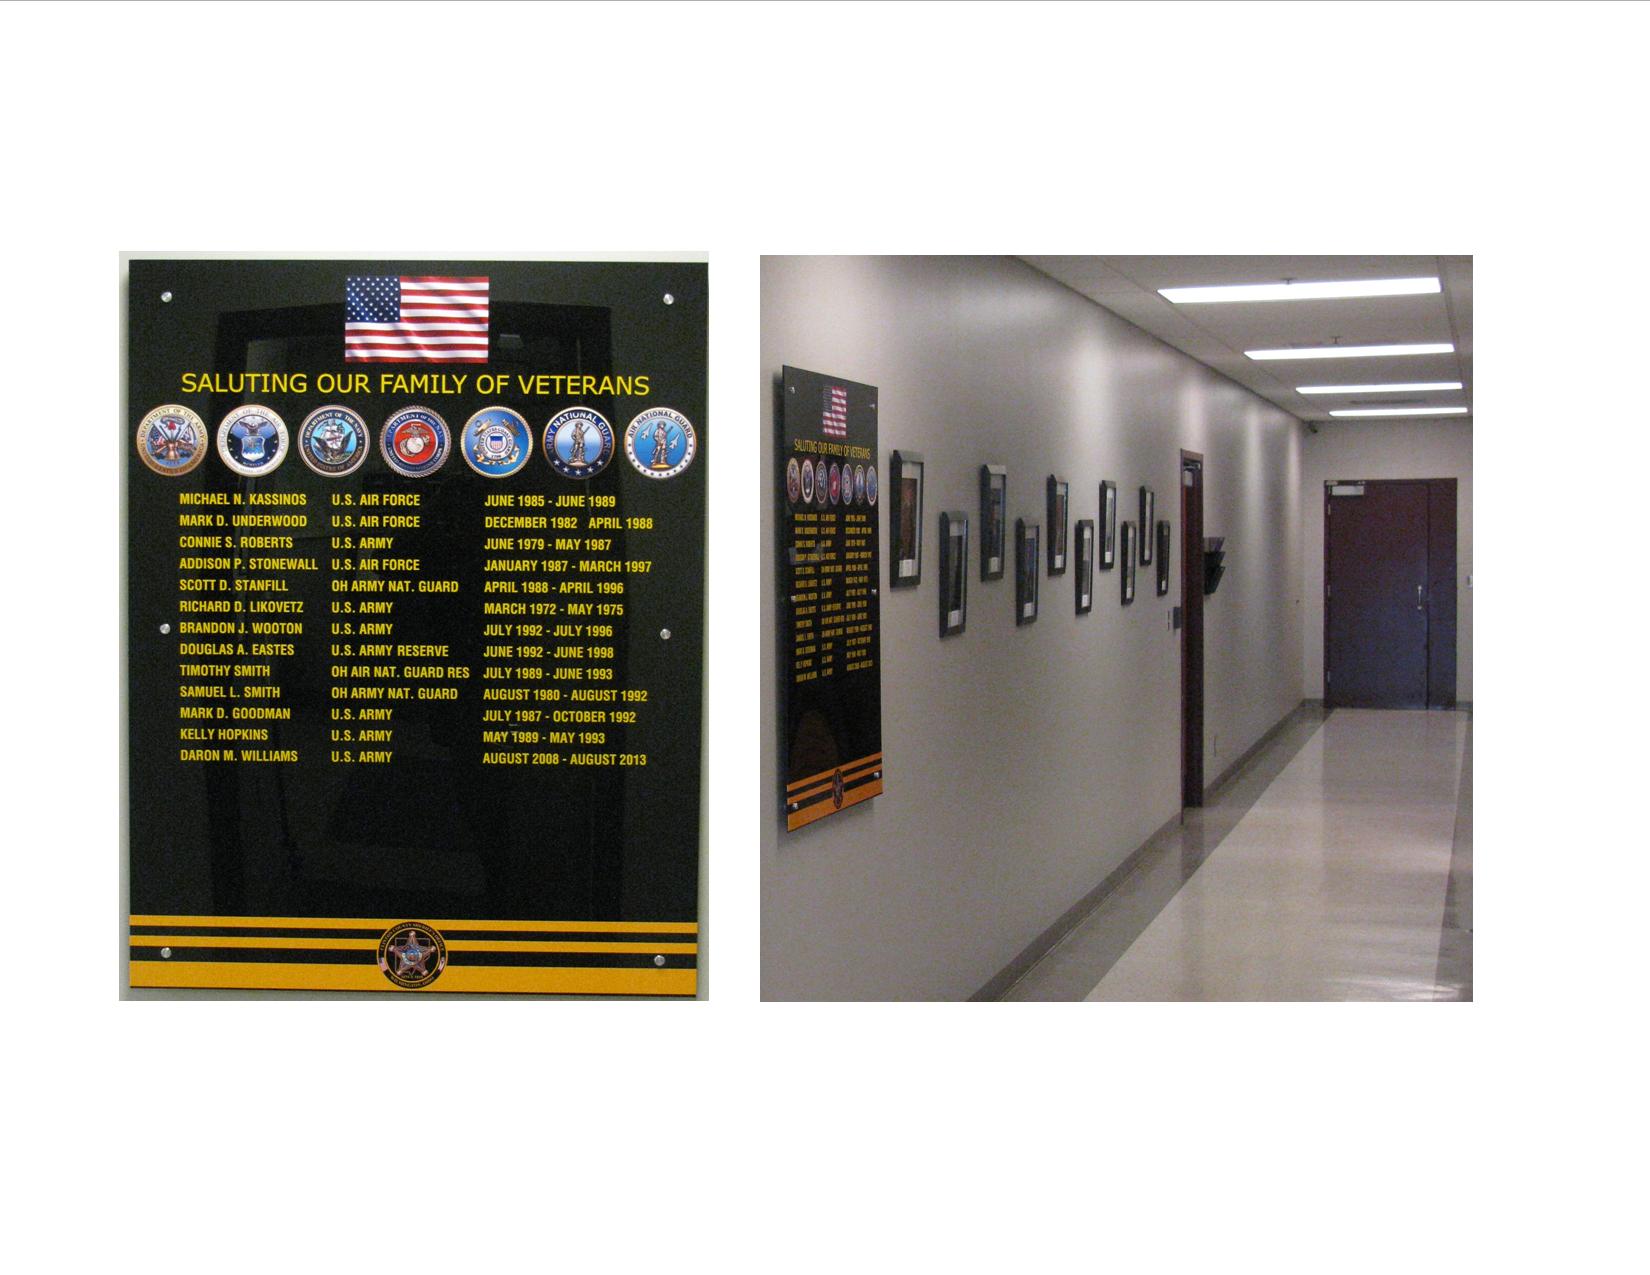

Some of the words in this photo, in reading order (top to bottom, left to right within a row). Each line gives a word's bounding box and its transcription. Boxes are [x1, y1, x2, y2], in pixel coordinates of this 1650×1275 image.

[181, 372, 307, 393] SALUTING
[317, 373, 371, 393] OUR
[381, 374, 467, 394] FAMILY
[476, 374, 510, 394] OF
[518, 375, 650, 396] VETERANS
[304, 412, 333, 438] DEPARTMENT
[628, 425, 638, 439] AIR
[637, 410, 673, 425] NATIONAL
[674, 415, 693, 439] GUARD
[546, 429, 555, 454] RMY
[553, 411, 597, 429] NATIONAL
[179, 493, 230, 505] MICHAEL
[233, 493, 246, 505] N.
[249, 493, 307, 505] KASSINOS
[332, 494, 355, 506] U.S.
[359, 494, 379, 505] AIR
[383, 494, 420, 506] FORCE
[484, 495, 514, 506] JUNE
[518, 495, 545, 507] 1985
[555, 495, 585, 507] JUNE
[587, 496, 616, 507] 1989
[179, 514, 213, 526] MARK
[216, 515, 228, 526] D.
[232, 514, 307, 527] UNDERWOOD
[332, 515, 356, 527] U.S.
[359, 516, 379, 527] AIR
[383, 516, 420, 528] FORCE
[485, 516, 547, 528] DECEMBER
[550, 517, 578, 528] 1982
[588, 517, 623, 529] APRIL
[626, 517, 654, 530] 1988
[179, 536, 222, 548] CONNIE
[225, 536, 236, 548] S.
[240, 536, 293, 548] ROBERTS
[332, 537, 355, 549] U.S.
[359, 537, 393, 549] ARMY
[484, 538, 514, 550] JUNE
[517, 538, 544, 550] 1979
[555, 538, 581, 550] MAY
[584, 539, 611, 551] 1987
[179, 557, 230, 569] ADDISON
[234, 558, 245, 569] P.
[249, 558, 318, 570] STONEWALL
[332, 559, 355, 570] U.S.
[359, 559, 379, 571] AIR
[383, 559, 420, 571] FORCE
[484, 560, 538, 571] JANUARY
[541, 560, 568, 572] 1987
[579, 560, 621, 572] MARCH
[625, 561, 652, 573] 1997
[180, 579, 216, 591] SCOTT
[219, 579, 231, 591] D.
[235, 579, 288, 591] STANFILL
[332, 580, 348, 592] OH
[351, 580, 385, 592] ARMY
[388, 581, 414, 592] NAT.
[418, 581, 459, 592] GUARD
[484, 581, 518, 593] APRIL
[521, 581, 548, 593] 1988
[559, 582, 593, 593] APRIL
[597, 582, 624, 594] 1996
[179, 600, 230, 612] RICHARD
[234, 601, 246, 612] D.
[250, 601, 303, 613] LIKOVETZ
[332, 602, 355, 613] U.S.
[359, 602, 393, 613] ARMY
[484, 603, 526, 614] MARCH
[530, 603, 556, 615] 1972
[568, 603, 593, 615] MAY
[596, 604, 623, 615] 1975
[180, 622, 235, 634] BRANDON
[238, 623, 248, 634] J.
[252, 622, 302, 634] WOOTON
[332, 623, 355, 635] U.S.
[359, 623, 393, 635] ARMY
[484, 624, 512, 636] JULY
[516, 625, 543, 636] 1992
[553, 625, 583, 637] JULY
[586, 625, 612, 637] 1996
[180, 643, 233, 655] DOUGLAS
[237, 644, 248, 655] A.
[252, 644, 294, 656] EASTES
[331, 644, 355, 656] U.S.
[359, 645, 392, 656] ARMY
[397, 645, 449, 657] RESERVE
[484, 646, 513, 657] JUNE
[517, 646, 543, 658] 1992
[554, 646, 584, 658] JUNE
[587, 647, 614, 658] 1998
[180, 664, 231, 676] TIMOTHY
[234, 665, 270, 677] SMITH
[331, 666, 347, 677] OH
[351, 666, 370, 677] AIR
[374, 666, 399, 677] NAT.
[404, 666, 444, 678] GUARD
[448, 667, 470, 678] RES
[483, 667, 512, 679] JULY
[515, 668, 542, 679] 1989
[553, 668, 582, 679] JUNE
[586, 668, 613, 680] 1993
[180, 686, 226, 697] SAMUEL
[230, 686, 240, 698] L.
[244, 686, 280, 698] SMITH
[332, 687, 347, 698] OH
[351, 687, 384, 699] ARMY
[388, 688, 413, 699] NAT.
[418, 688, 458, 699] GUARD
[483, 689, 530, 700] AUGUST
[533, 689, 560, 701] 1980
[571, 689, 617, 701] AUGUST
[621, 690, 648, 702] 1992
[180, 707, 213, 718] MARK
[217, 707, 228, 718] D.
[232, 707, 290, 719] GOODMAN
[331, 708, 355, 720] U.S.
[359, 709, 392, 720] ARMY
[483, 710, 512, 721] JULY
[515, 710, 542, 722] 1987
[553, 711, 606, 722] OCTOBER
[609, 711, 636, 723] 1992
[180, 728, 215, 740] KELLY
[218, 729, 268, 740] HOPKINS
[331, 730, 355, 741] U.S.
[359, 730, 392, 742] ARMY
[483, 731, 508, 743] MAY
[512, 731, 539, 743] 1989
[550, 732, 575, 743] MAY
[578, 732, 605, 744] 1993
[180, 749, 220, 761] DARON
[224, 750, 237, 761] M.
[241, 750, 298, 762] WILLIAMS
[331, 751, 355, 762] U.S.
[359, 751, 392, 763] ARMY
[483, 752, 529, 764] AUGUST
[532, 753, 559, 765] 2008
[570, 754, 617, 765] AUGUST
[619, 754, 646, 765] 2013
